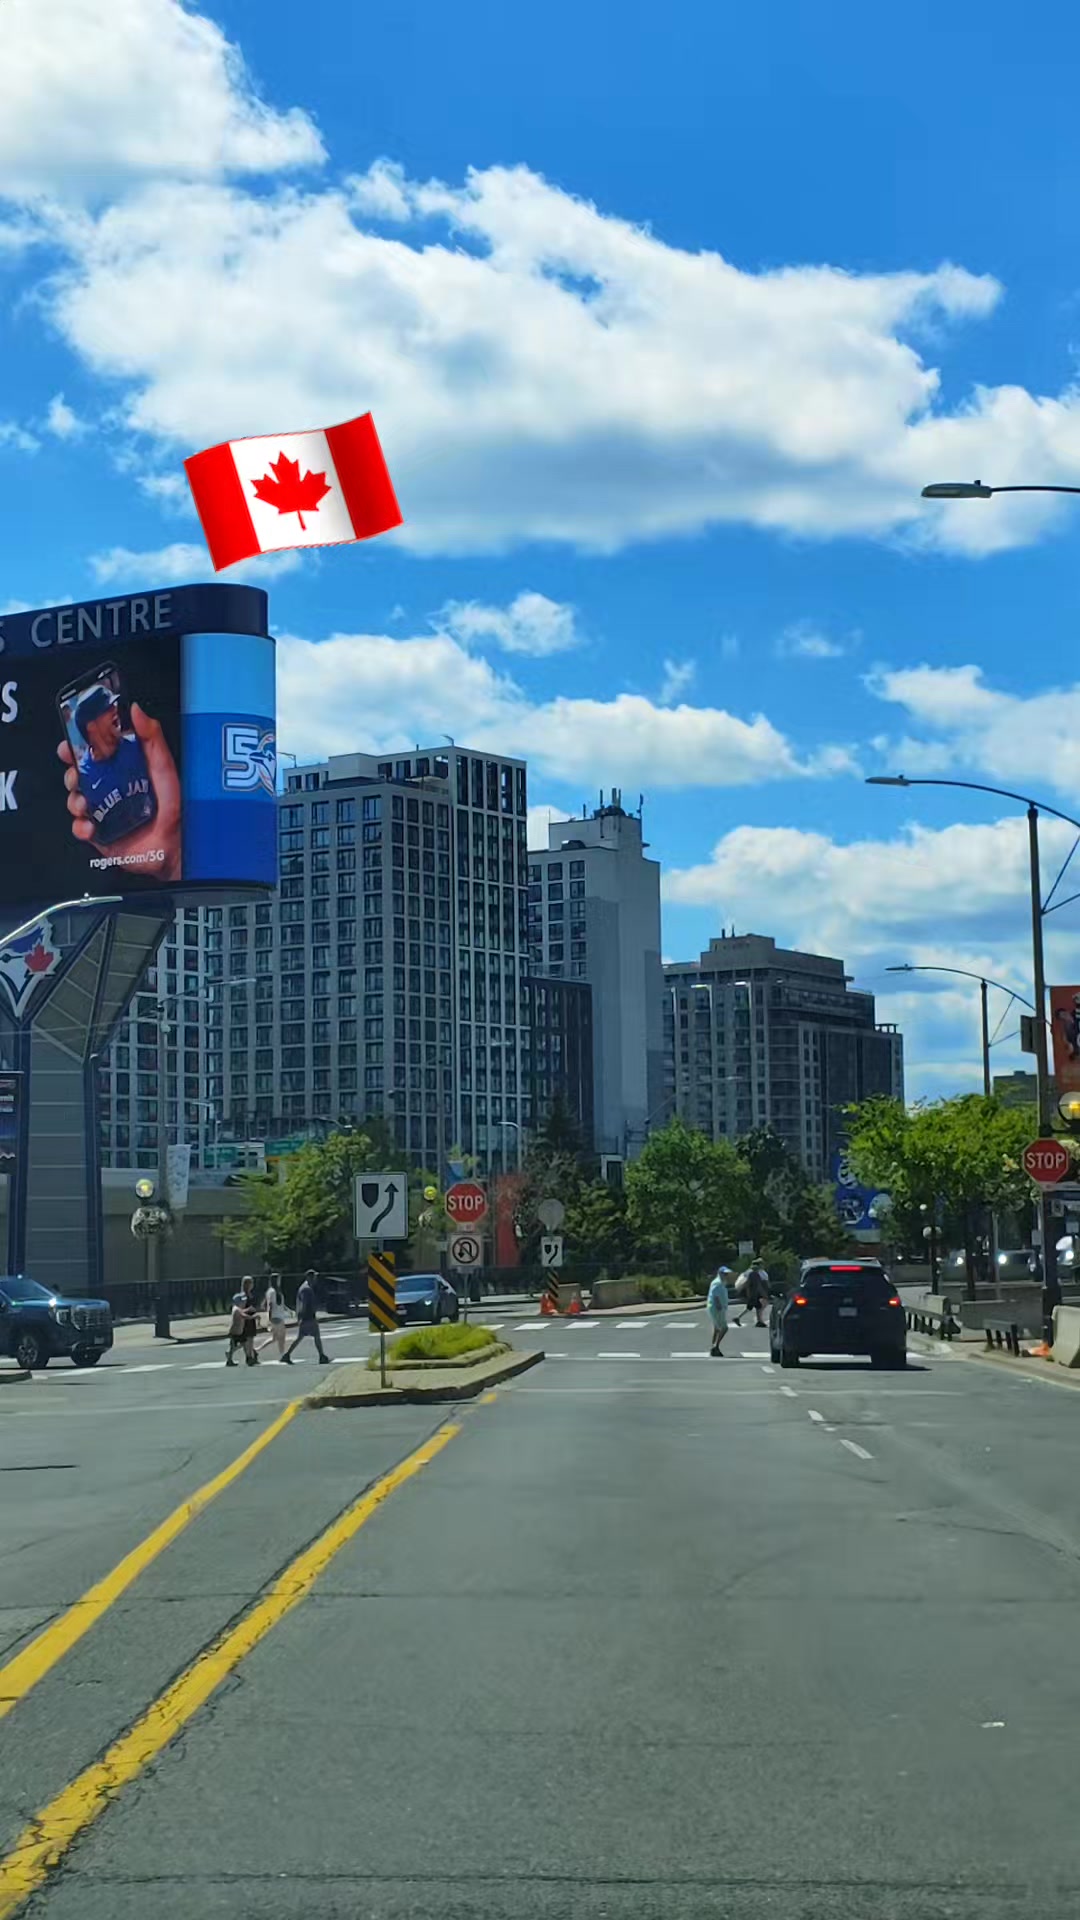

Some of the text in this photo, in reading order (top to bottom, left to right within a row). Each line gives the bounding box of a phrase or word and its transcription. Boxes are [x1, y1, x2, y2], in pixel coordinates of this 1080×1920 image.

[31, 594, 172, 648] CENTRE
[93, 788, 122, 823] BLUE
[89, 849, 165, 870] rogers.com/5G
[1026, 1152, 1066, 1169] STOP
[447, 1195, 484, 1211] STOP
